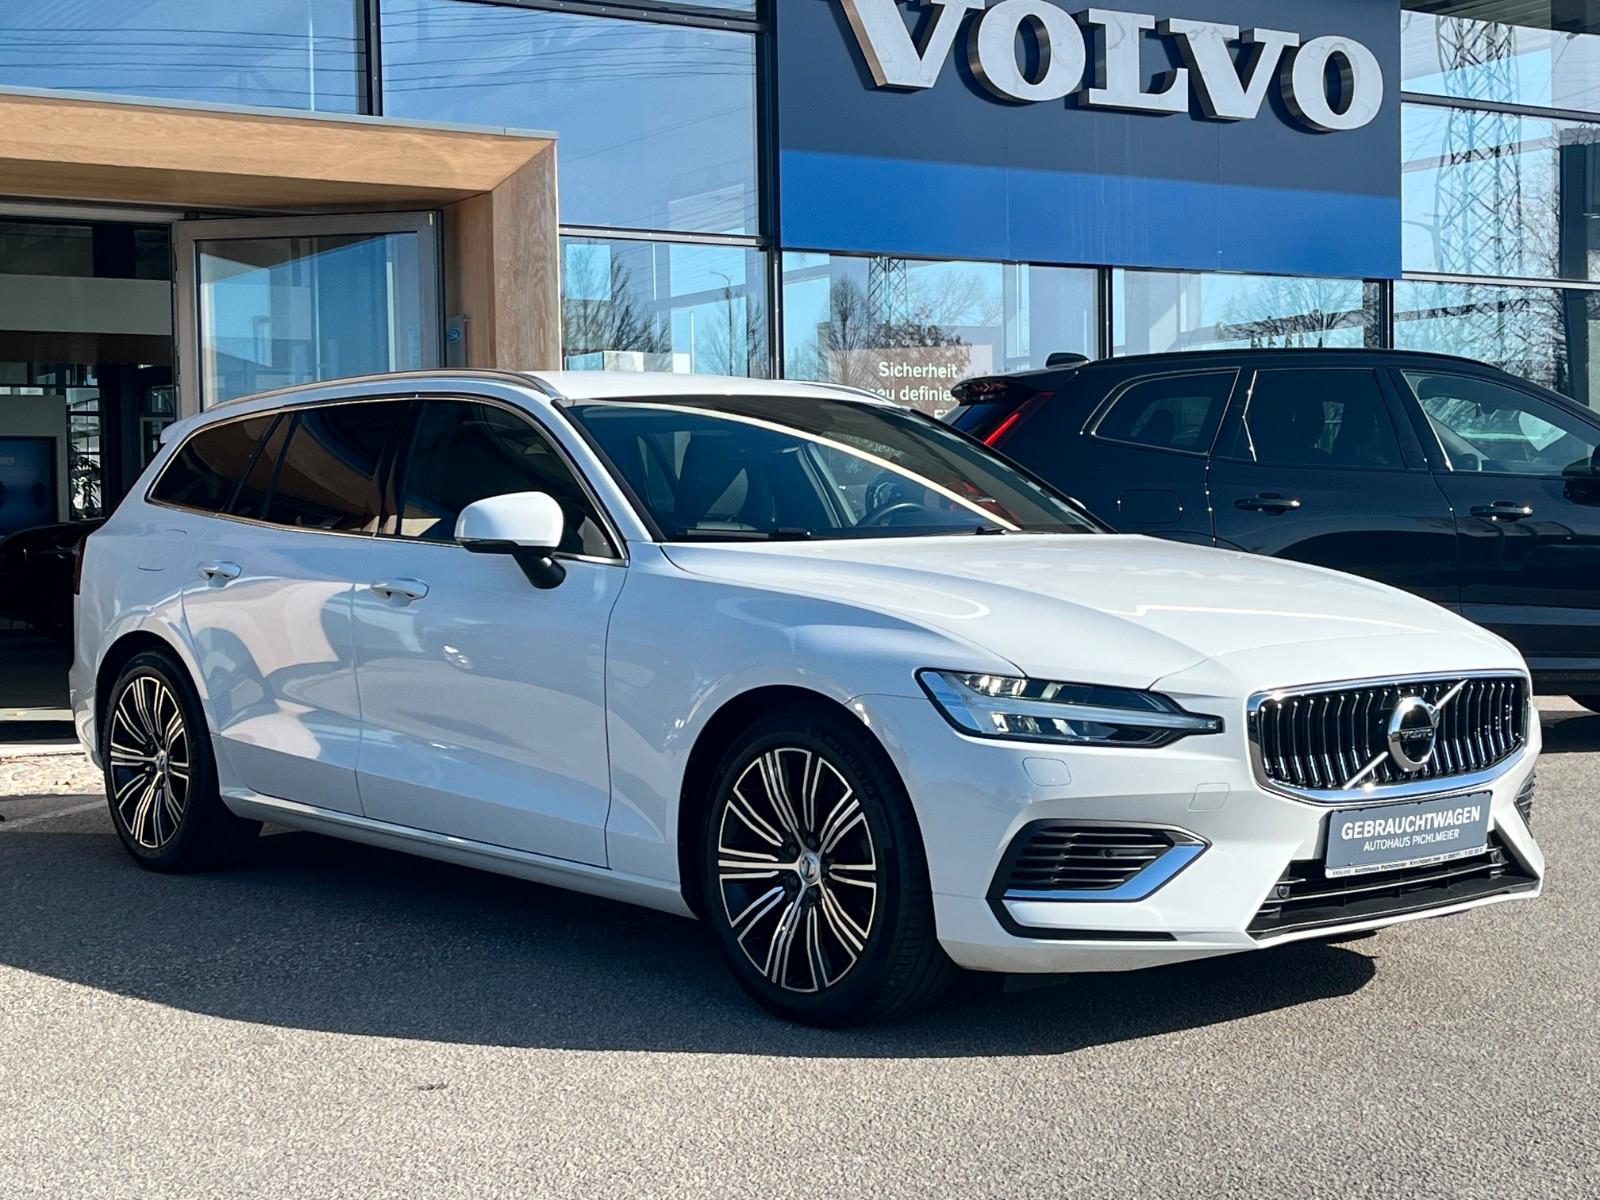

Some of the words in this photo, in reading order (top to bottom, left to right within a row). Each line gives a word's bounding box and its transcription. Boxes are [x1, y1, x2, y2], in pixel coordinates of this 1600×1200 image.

[841, 0, 1384, 131] VOLVO
[878, 361, 958, 378] Sicherheit
[900, 385, 955, 401] definie
[1341, 805, 1481, 840] GEBRAUCHTWAGEN
[1363, 837, 1411, 852] AUTOHAUS
[1412, 828, 1460, 845] PICHLMEIER
